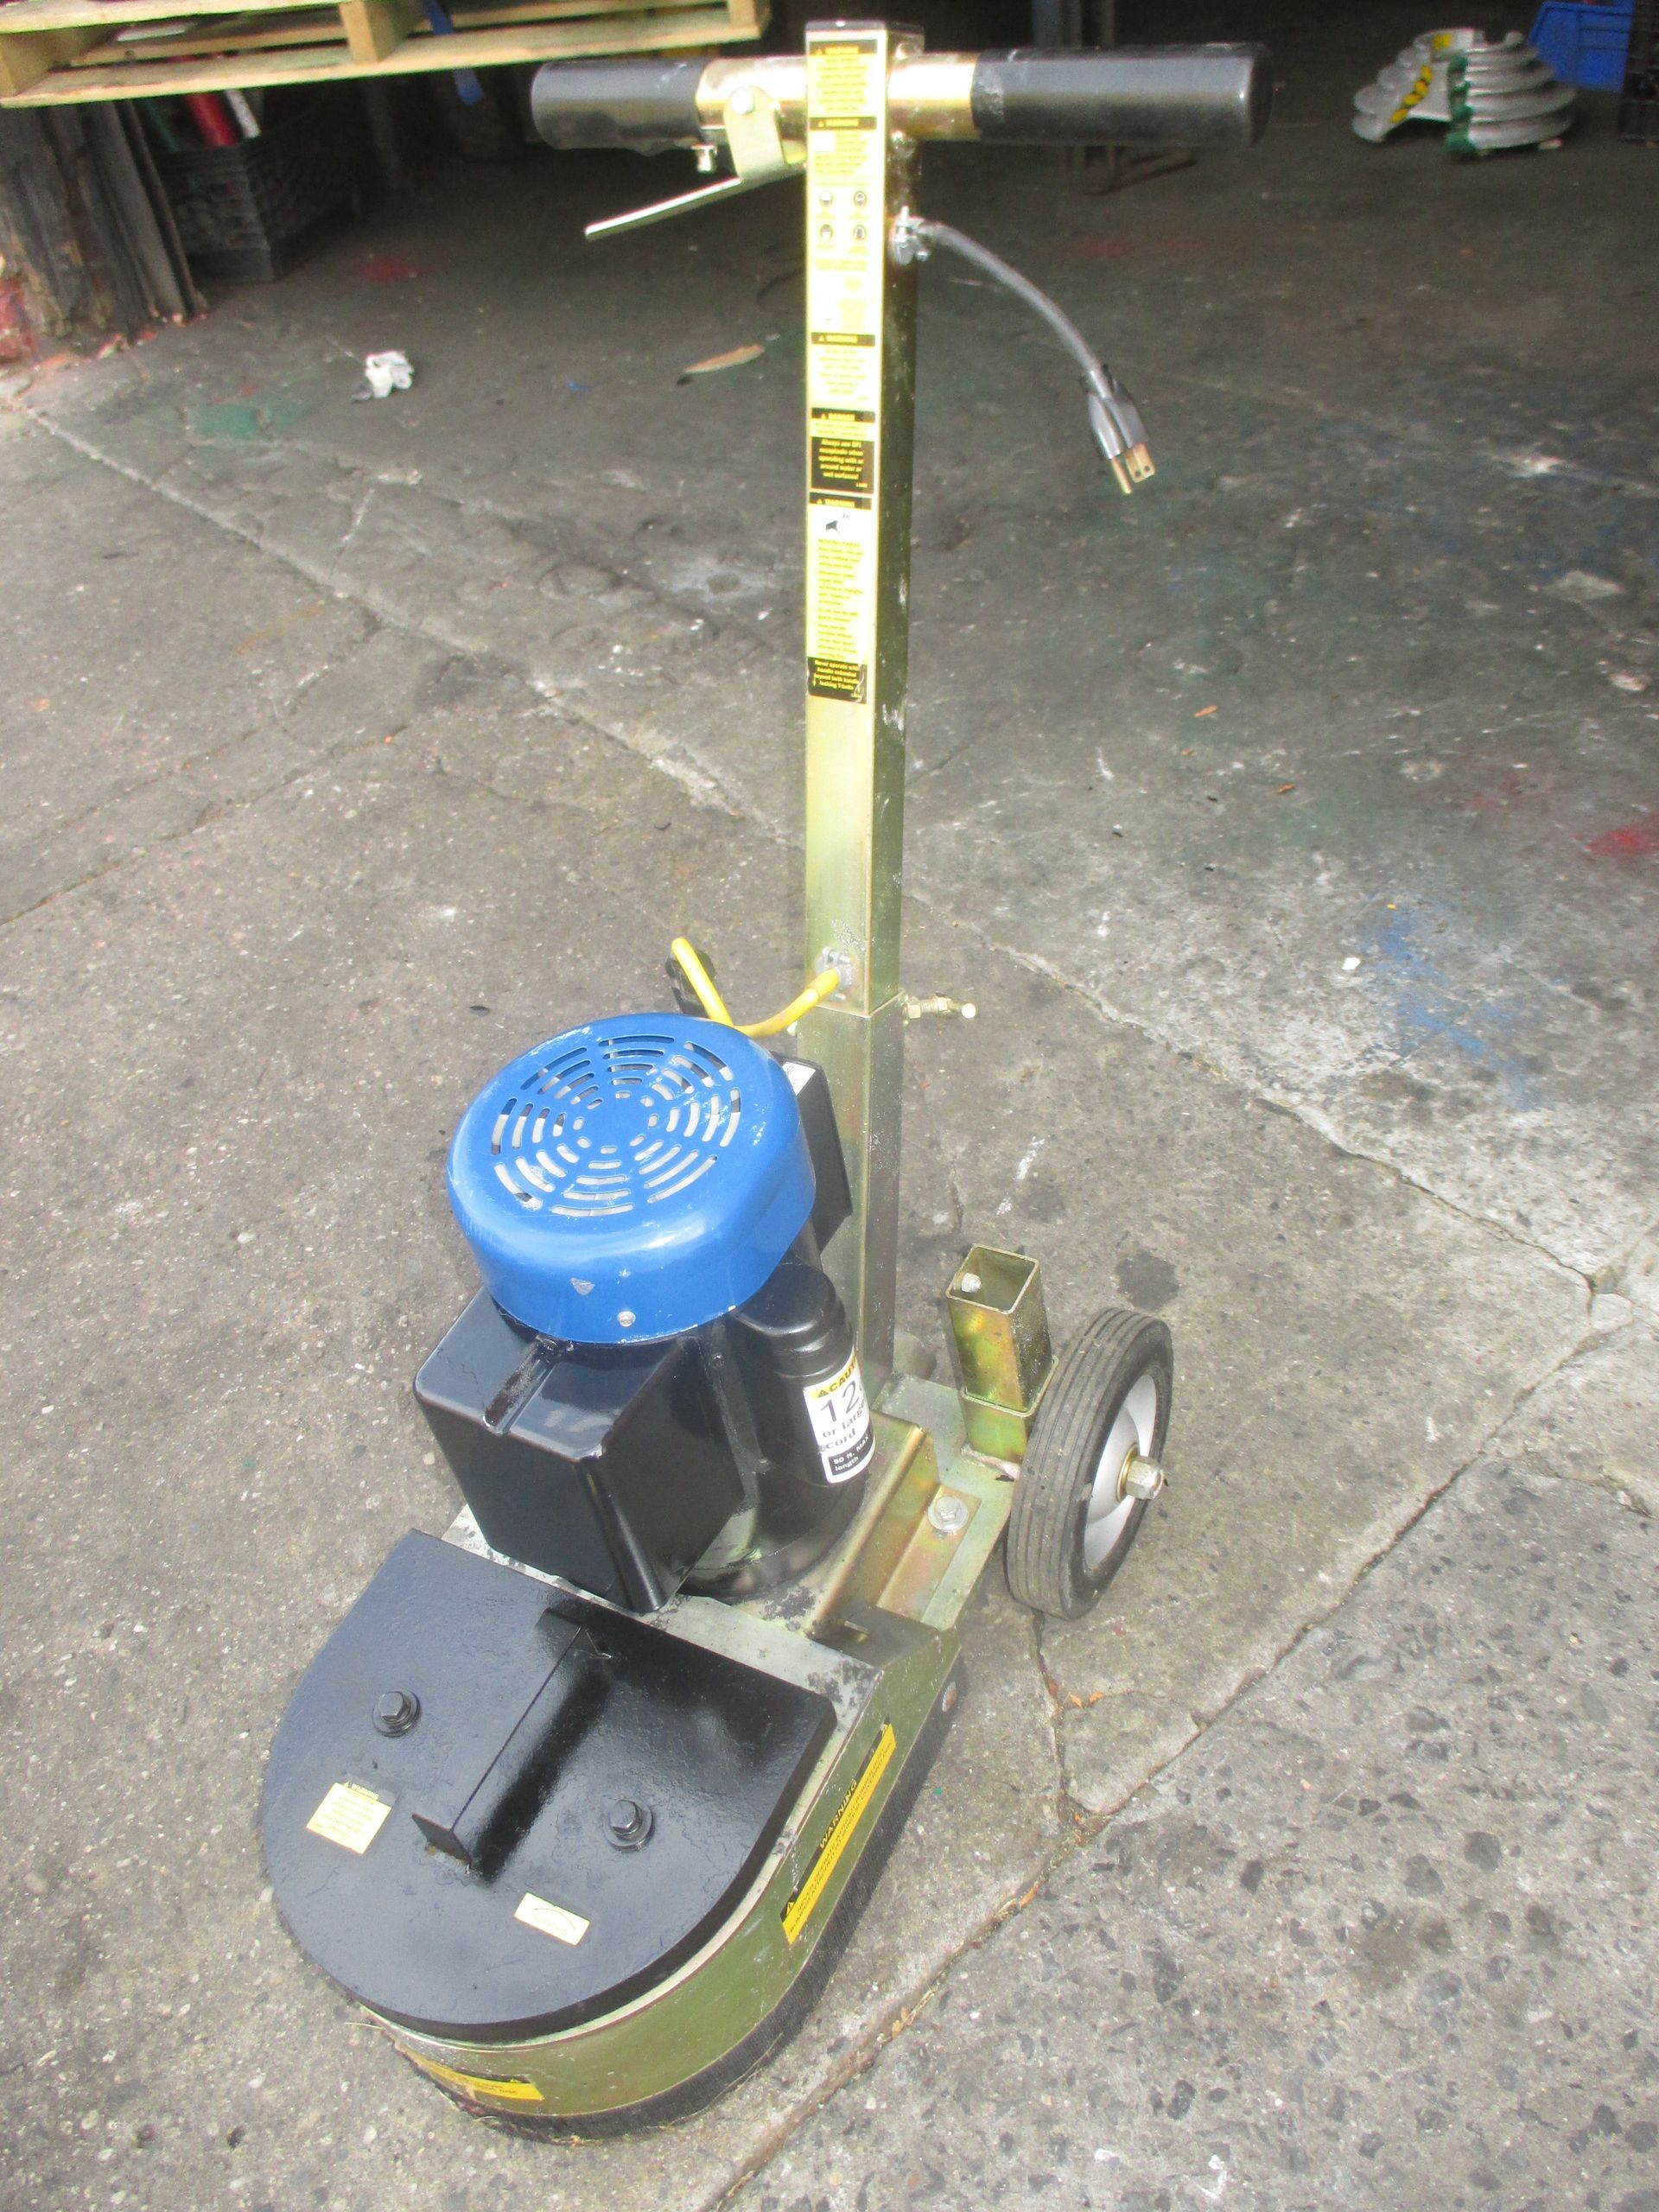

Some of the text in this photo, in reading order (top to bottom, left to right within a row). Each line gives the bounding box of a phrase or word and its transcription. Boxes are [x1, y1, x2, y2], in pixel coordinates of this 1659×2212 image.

[821, 1381, 860, 1422] 12
[823, 1428, 836, 1438] or
[826, 1427, 855, 1449] cord
[835, 1456, 859, 1471] length
[820, 1779, 857, 1849] WARNING
